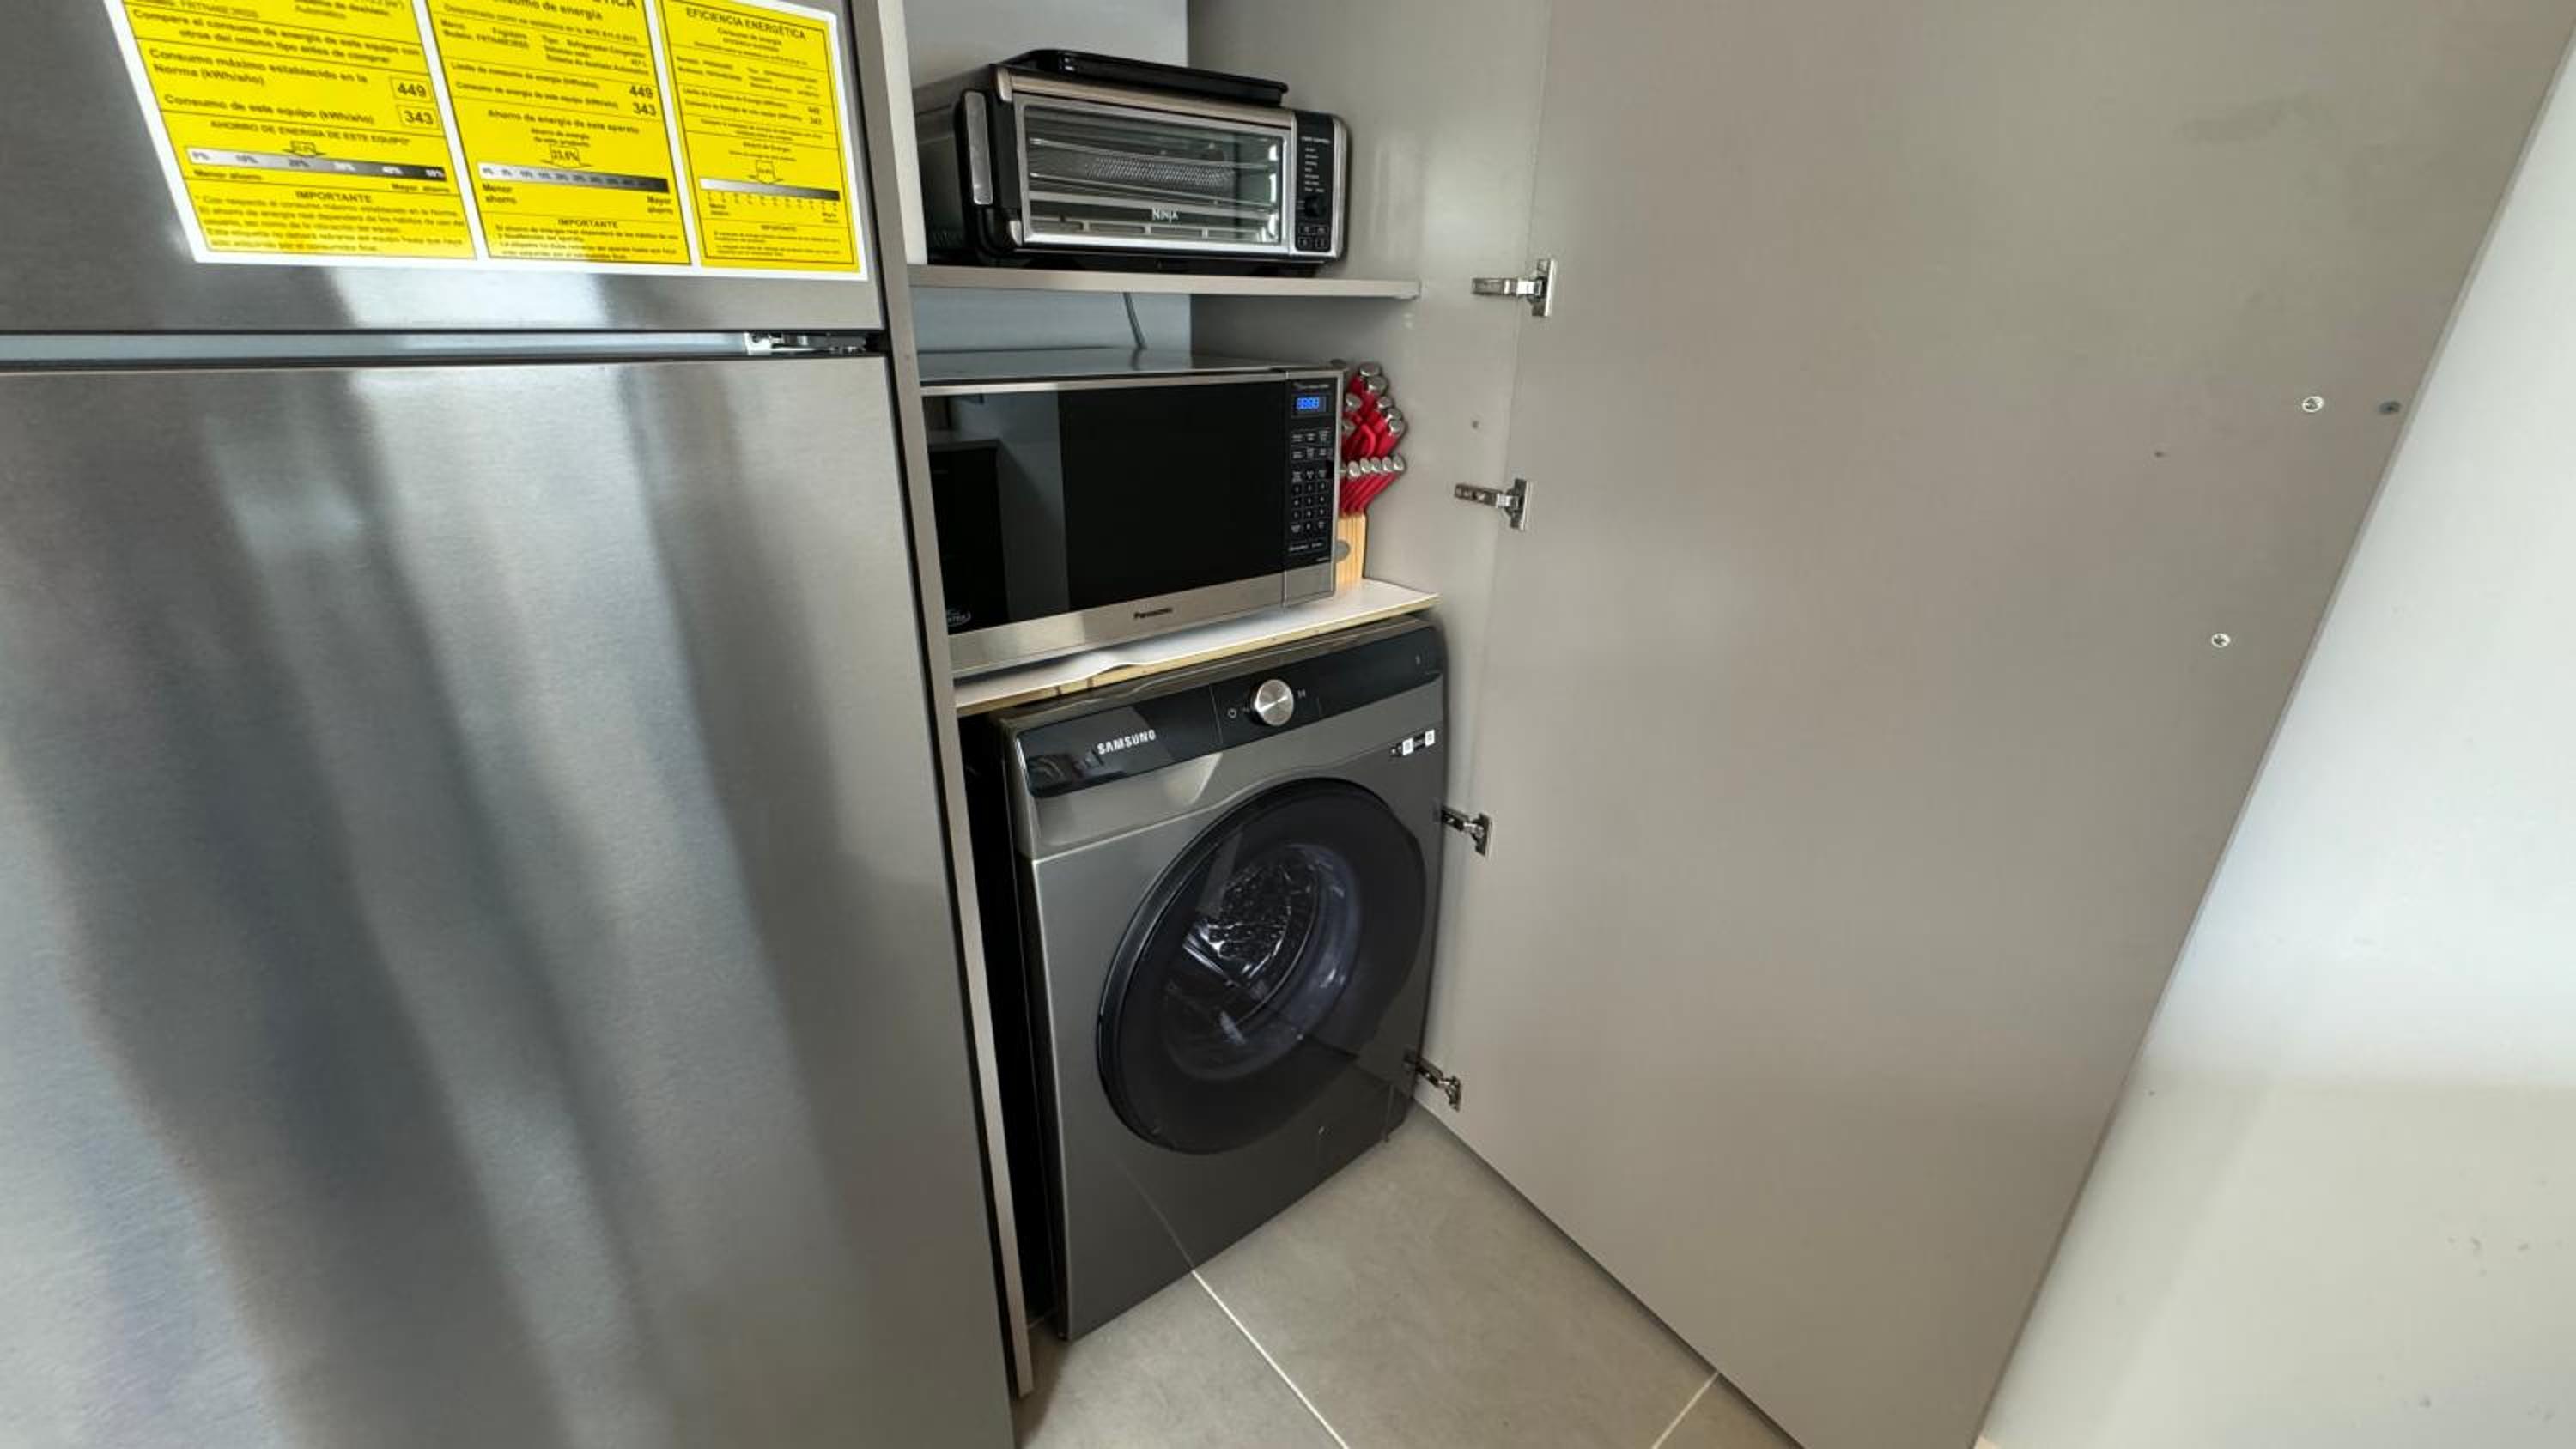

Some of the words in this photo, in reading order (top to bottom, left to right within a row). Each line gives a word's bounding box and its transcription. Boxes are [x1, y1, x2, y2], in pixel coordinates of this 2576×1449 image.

[398, 82, 427, 98] 449
[629, 86, 654, 100] 449
[632, 102, 657, 117] 343
[404, 111, 434, 125] 343
[1097, 728, 1157, 756] SAMSUNG
